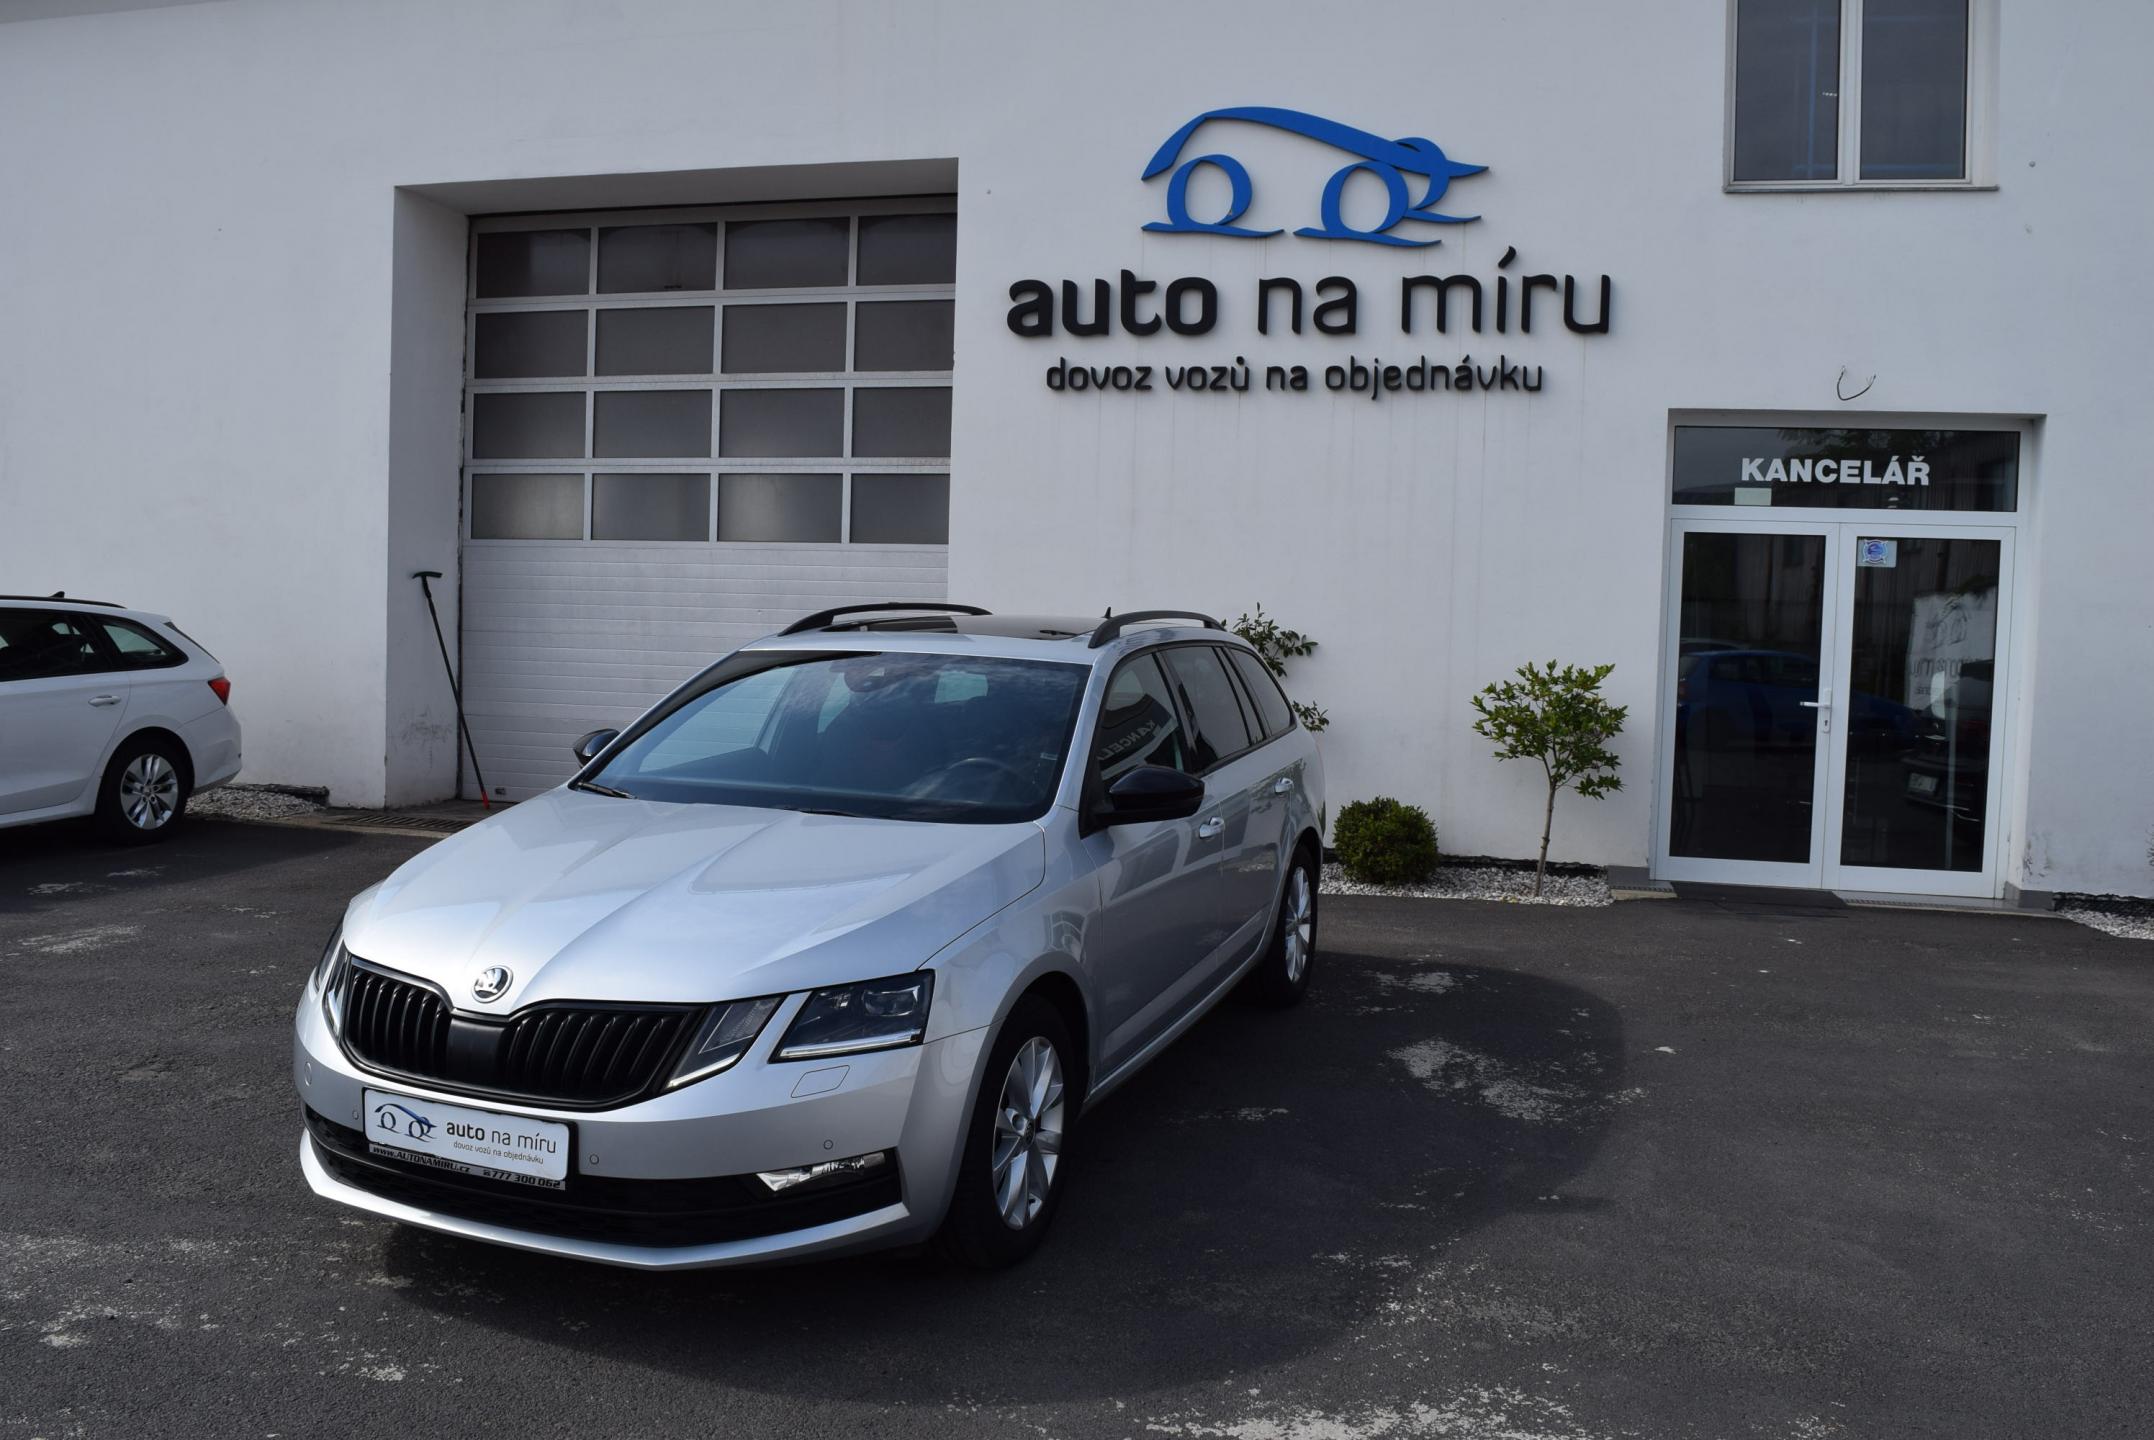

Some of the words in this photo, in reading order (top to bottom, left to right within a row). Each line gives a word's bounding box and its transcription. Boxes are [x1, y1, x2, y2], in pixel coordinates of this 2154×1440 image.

[1006, 269, 1218, 336] auto
[1258, 274, 1357, 335] na
[1402, 246, 1612, 335] míru
[1046, 356, 1152, 391] dovoz
[1165, 356, 1250, 392] vozů
[1266, 366, 1309, 391] na
[1325, 355, 1545, 400] objednávku
[1741, 456, 1930, 485] KANCELÁŘ
[447, 1122, 485, 1141] auto
[491, 1130, 511, 1146] na
[517, 1132, 556, 1154] míru
[454, 1141, 474, 1152] dovoz
[474, 1144, 491, 1155] vozů
[493, 1149, 502, 1157] na
[503, 1151, 544, 1165] objednávku
[492, 1169, 512, 1181] 777
[514, 1174, 536, 1185] 300
